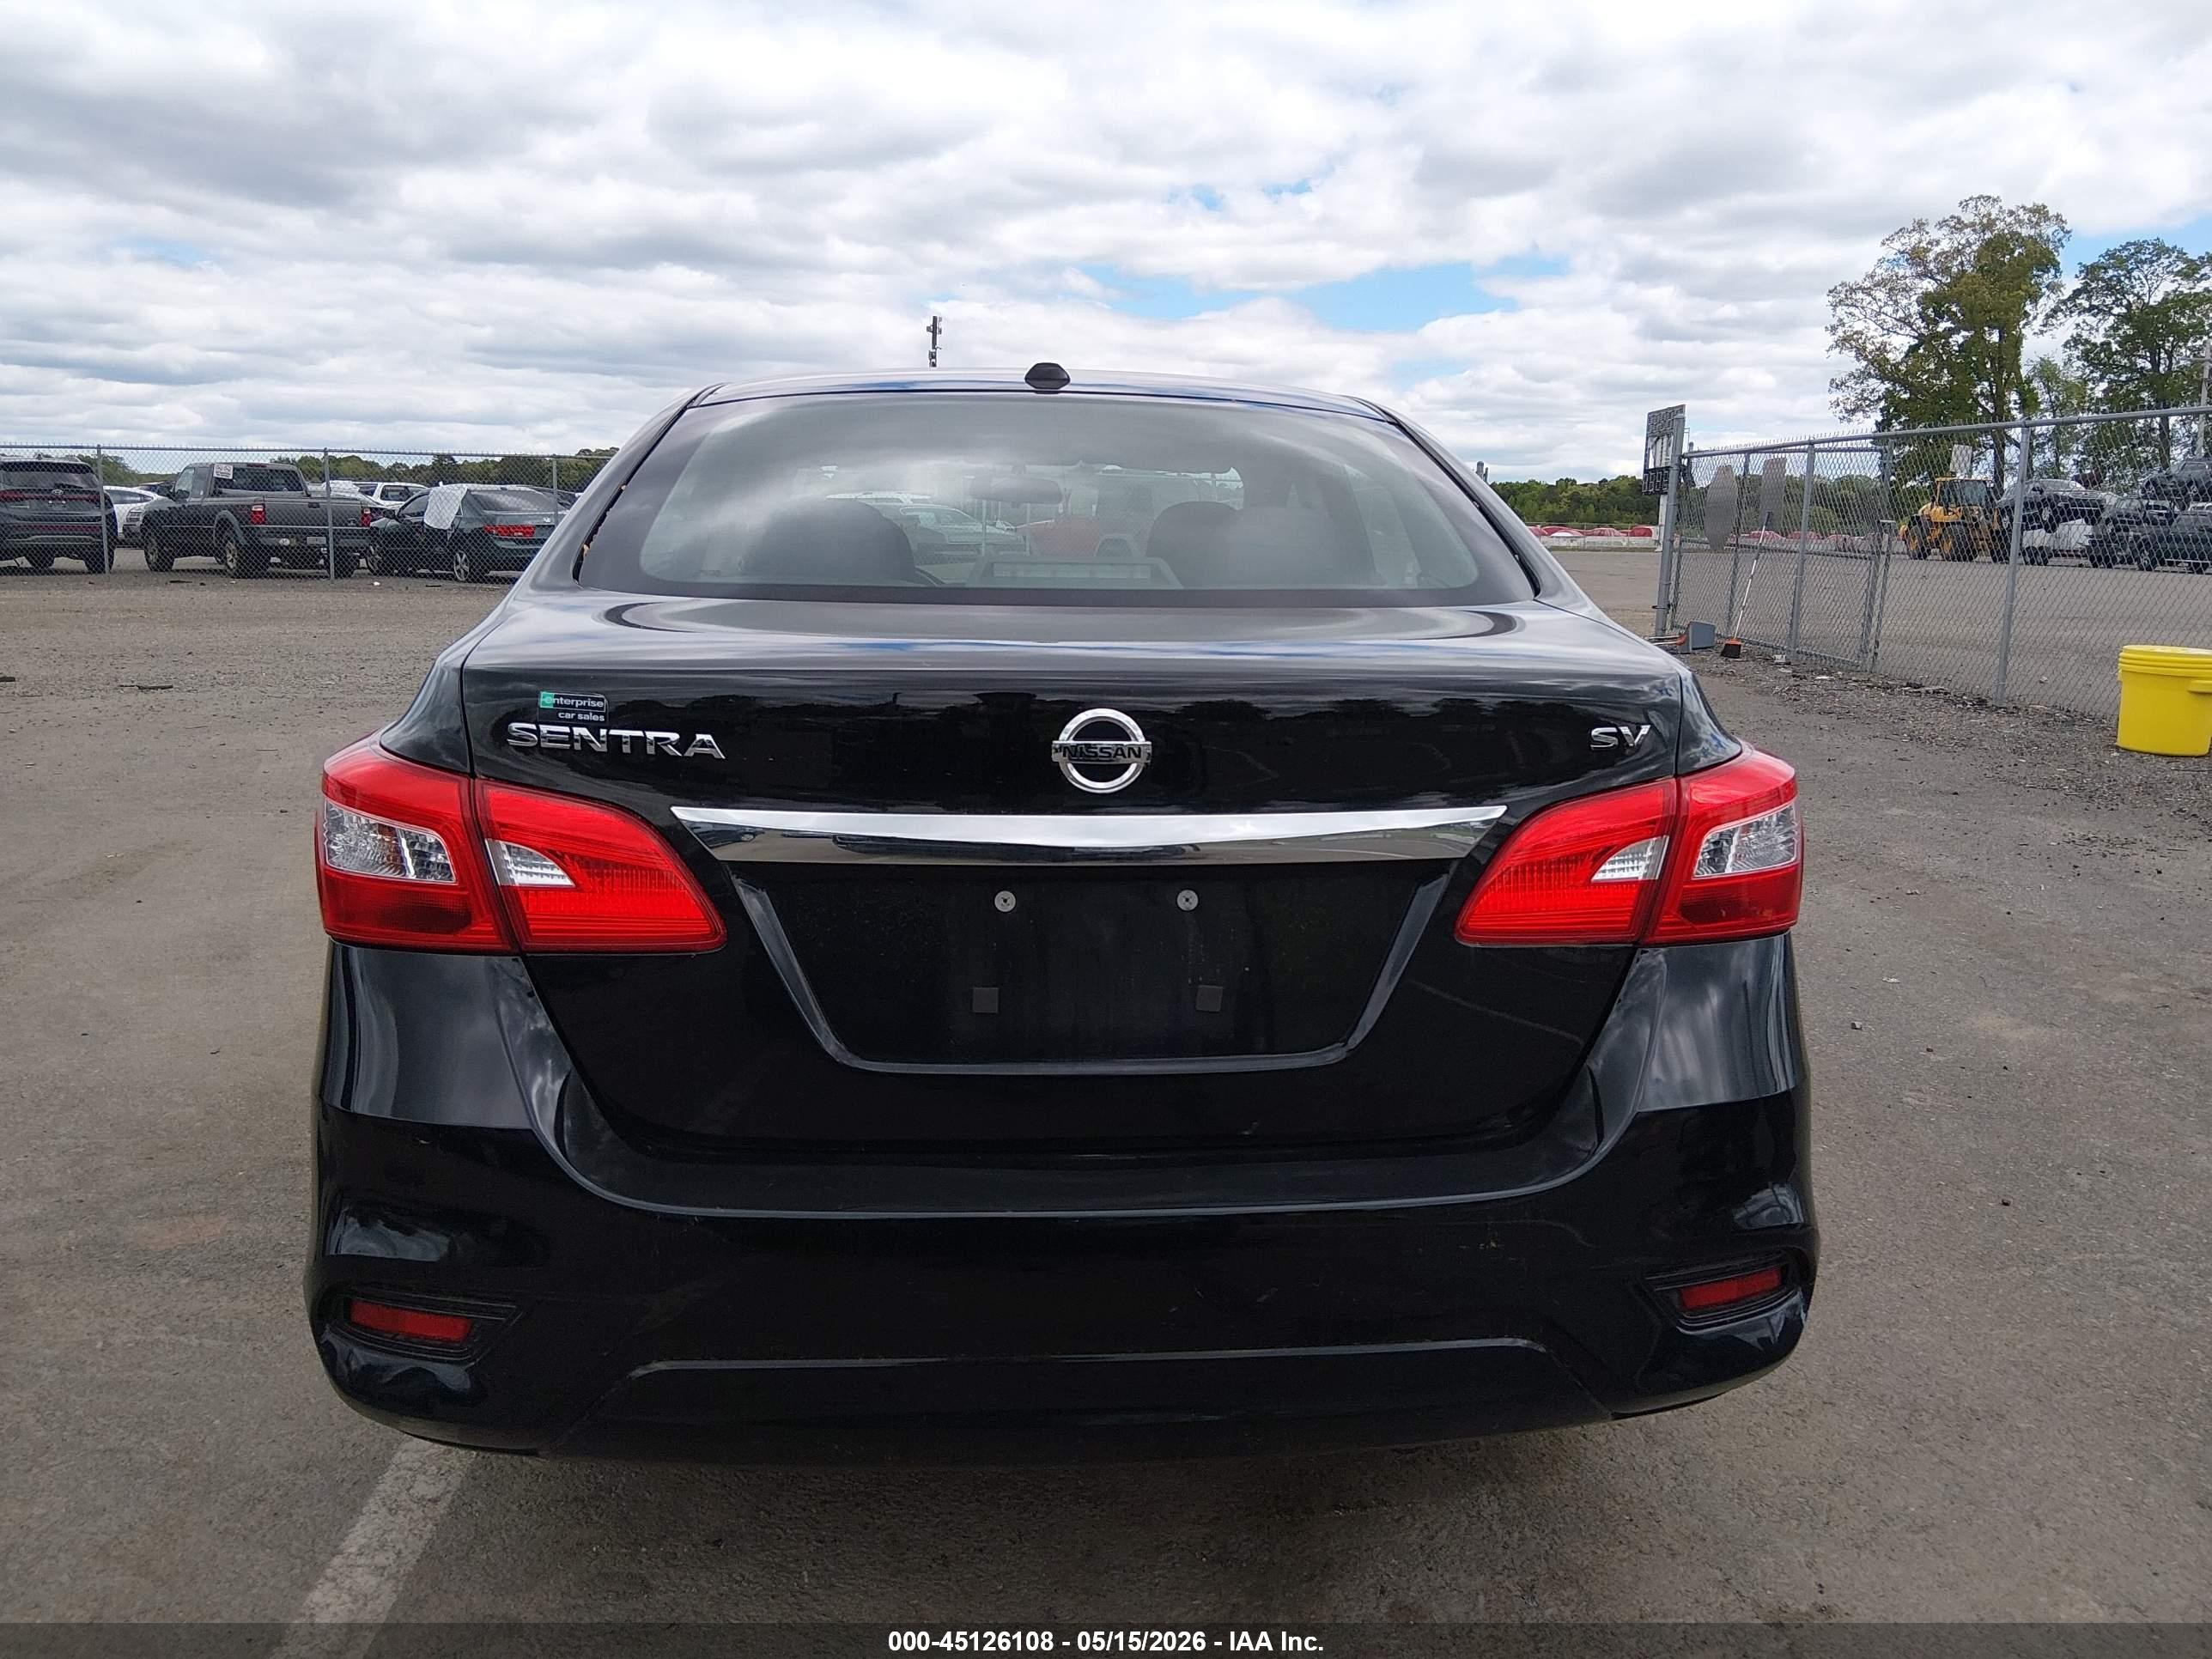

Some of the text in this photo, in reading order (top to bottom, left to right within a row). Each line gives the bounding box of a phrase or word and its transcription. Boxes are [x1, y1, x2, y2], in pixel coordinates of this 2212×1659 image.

[540, 696, 605, 708] enterprise
[577, 712, 605, 721] sales
[507, 722, 726, 759] SENTRA
[1589, 725, 1651, 750] SV
[1062, 745, 1142, 758] NISSAN
